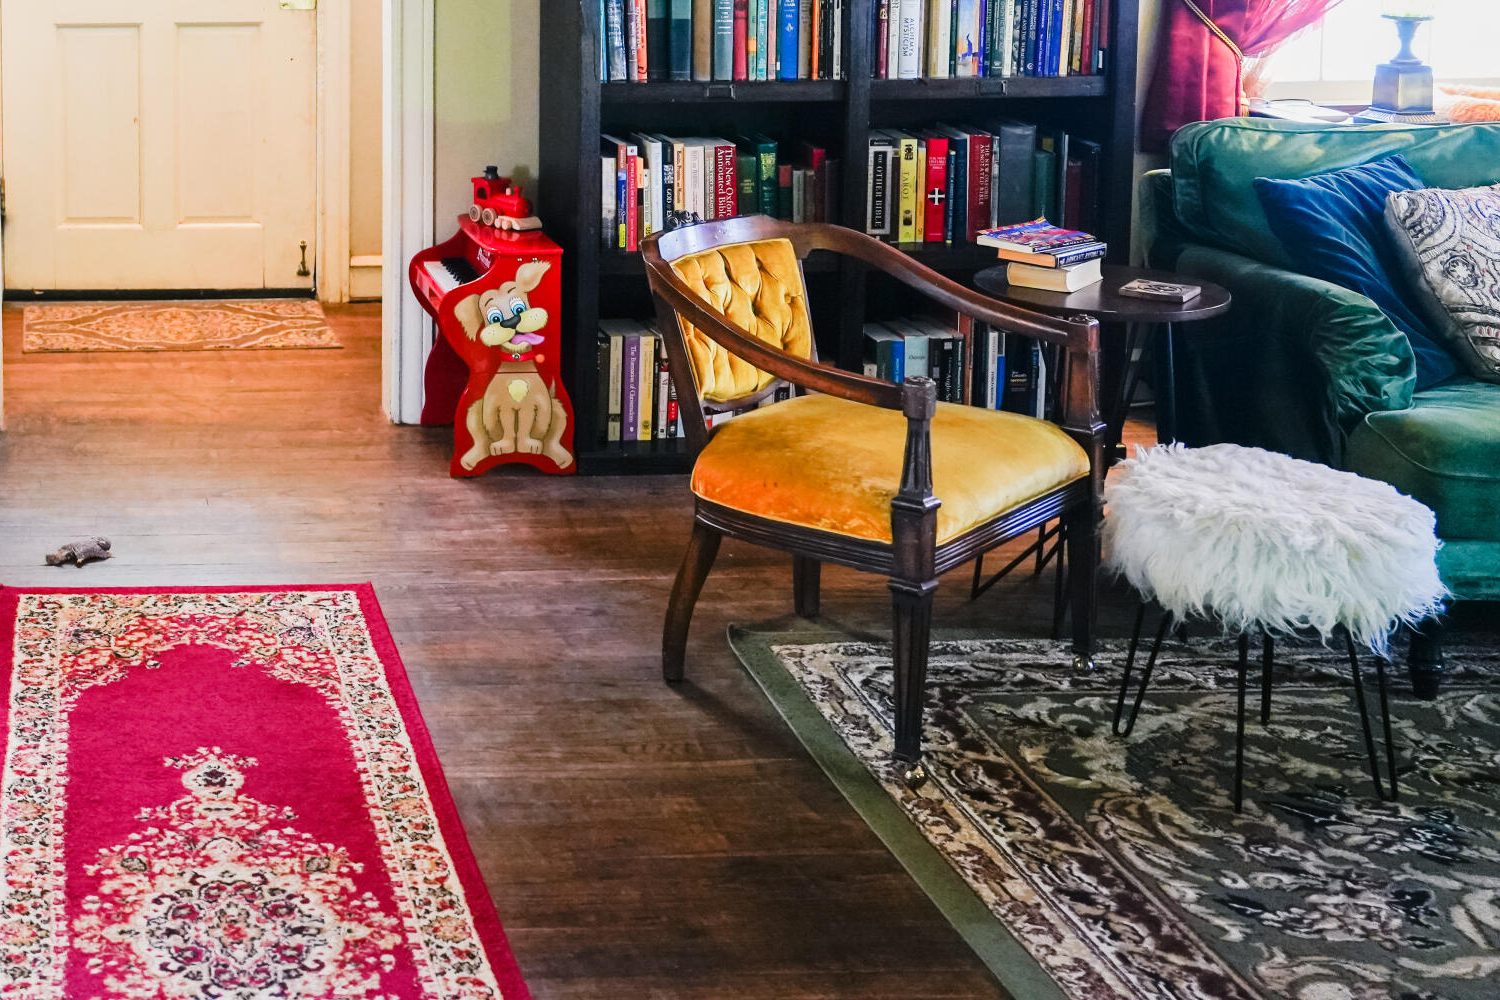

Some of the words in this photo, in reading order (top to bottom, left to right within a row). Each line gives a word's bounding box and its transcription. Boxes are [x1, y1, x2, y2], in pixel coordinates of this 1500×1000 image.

[717, 148, 725, 194] Annotated
[725, 148, 733, 166] The
[725, 167, 733, 187] New
[875, 166, 883, 197] OTHER
[902, 171, 910, 200] TAROT
[874, 200, 882, 227] BIBLE
